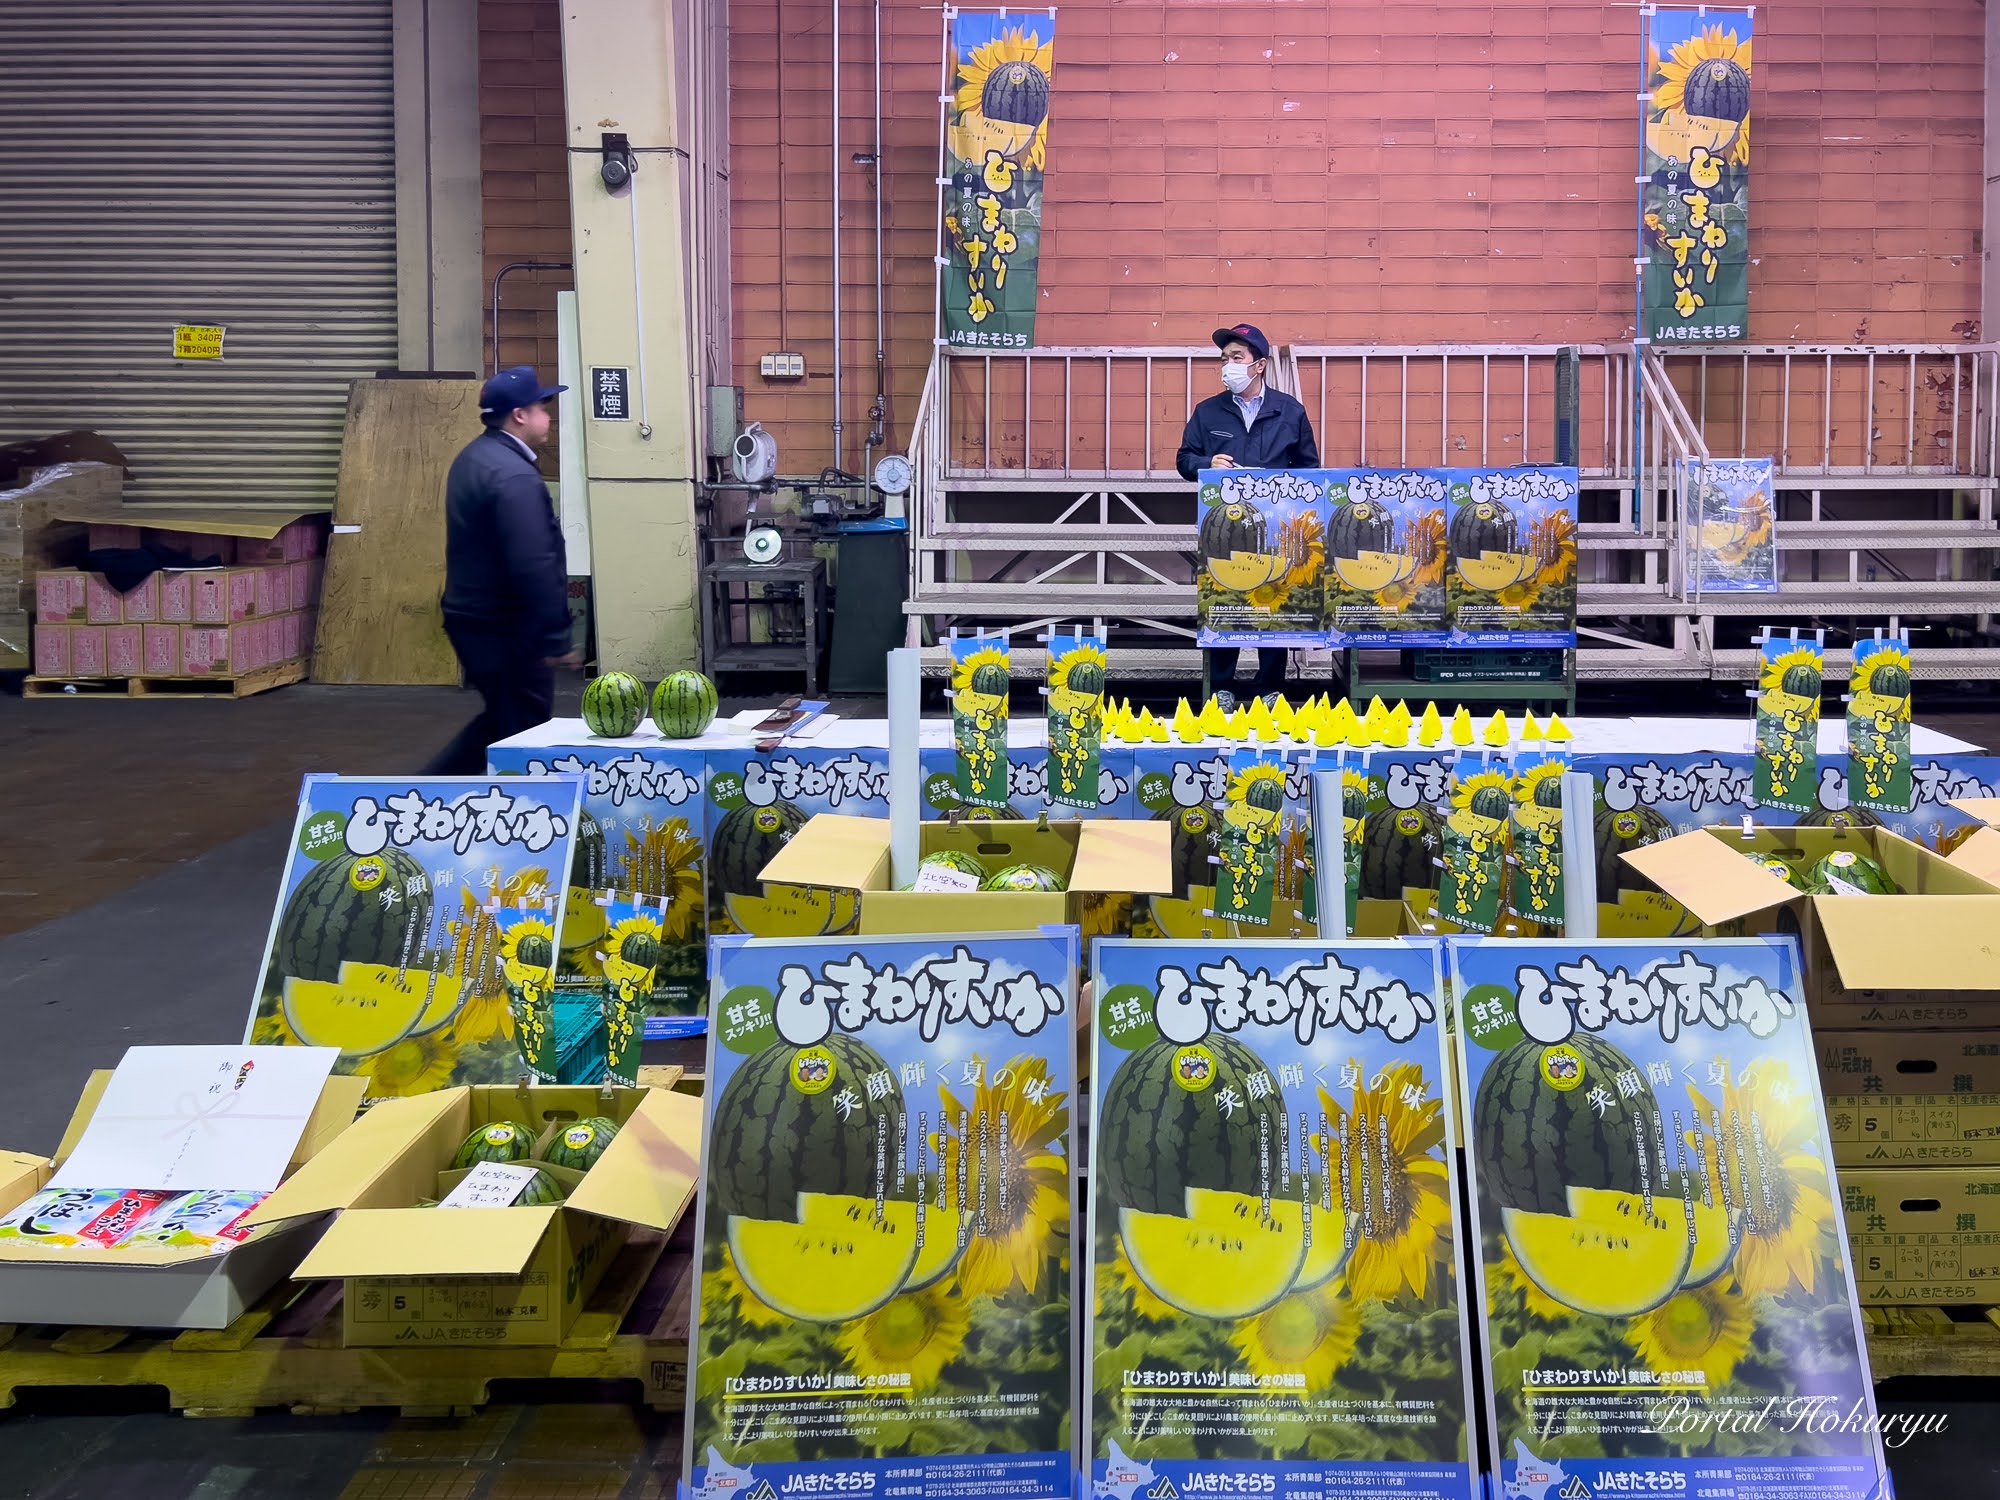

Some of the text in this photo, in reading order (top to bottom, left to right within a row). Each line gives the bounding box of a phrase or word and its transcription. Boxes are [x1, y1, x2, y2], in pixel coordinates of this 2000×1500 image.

[1666, 155, 1677, 231] あの夏の味。
[977, 149, 1019, 290] ひまわり
[1682, 146, 1728, 285] ひまわり
[962, 234, 995, 324] すいか
[1665, 230, 1704, 319] すいか
[198, 334, 221, 342] 340円
[949, 330, 1027, 348] JAきたそらち
[1655, 324, 1741, 340] JAきたそらち
[600, 370, 622, 416] 禁煙
[1220, 471, 1323, 504] ひまわりすいか
[1347, 471, 1446, 503] ひまわりすいか
[1469, 470, 1575, 504] ひまわりすいか
[1228, 634, 1259, 642] JAきたそらち
[1354, 634, 1386, 642] JAきたそらち
[1477, 634, 1509, 642] JAきたそらち
[972, 708, 999, 779] ひまわり
[1066, 707, 1090, 779] ひまわり
[1779, 709, 1804, 782] ひまわり
[1869, 709, 1896, 783] ひまわり
[965, 750, 987, 796] すいか
[1057, 749, 1077, 795] すいか
[1768, 751, 1790, 798] すいか
[1860, 751, 1886, 799] すいか
[715, 779, 736, 792] 甘さ
[930, 779, 950, 793] 甘さ
[1143, 780, 1163, 793] 甘さ
[965, 795, 1007, 810] JAきたそらち
[1054, 794, 1097, 810] JAきたそらち
[1760, 798, 1811, 813] JAきたそらち
[1856, 799, 1909, 814] JAきたそらち
[307, 819, 337, 838] 甘さ
[343, 785, 569, 856] ひまわりすいか
[304, 830, 343, 851] スッキリ!!
[1241, 822, 1265, 895] ひまわり
[1466, 830, 1489, 903] ひまわり
[1533, 822, 1558, 896] ひまわり
[1230, 862, 1250, 912] すいか
[1454, 870, 1474, 915] すいか
[1526, 863, 1550, 912] すいか
[1221, 911, 1269, 926] JAきたそらち
[1444, 913, 1493, 934] JAきたそらち
[1522, 912, 1564, 926] JAきたそら
[777, 945, 1065, 1049] ひまわりすいか
[1153, 952, 1436, 1045] ひまわりすいか
[1515, 950, 1796, 1046] ひまわりすいか
[521, 980, 546, 1052] ひまわり
[726, 999, 761, 1026] 甘さ
[1108, 997, 1141, 1020] 甘さ
[1471, 999, 1504, 1021] 甘さ
[1888, 1008, 1968, 1020] JAきたそらち
[724, 1011, 773, 1042] スッキリ!!
[1108, 1010, 1153, 1037] スッキリ!!
[1472, 1012, 1516, 1038] スッキリ!!
[518, 1020, 539, 1065] すいか
[1842, 1057, 1872, 1073] 元気村
[833, 1058, 1055, 1122] 笑顔輝く夏の味。
[1214, 1063, 1434, 1121] 笑顔輝く夏の味。
[1864, 1074, 1973, 1092] 共 撰
[1834, 1113, 1853, 1132] 秀
[1865, 1118, 1878, 1131] 5
[1893, 1146, 1973, 1159] JAきたそらち
[1845, 1195, 1876, 1212] 元気村
[1867, 1213, 1976, 1232] 共 撰
[1869, 1257, 1881, 1271] 5
[394, 1296, 406, 1309] 5
[1896, 1286, 1976, 1299] JAきたそらち
[423, 1327, 507, 1340] JAきたそらち
[725, 1372, 911, 1394] 「ひまわりすいか」美味しさの秘密
[1123, 1370, 1306, 1388] 「ひまわりすいか」美味しさの秘密
[1522, 1368, 1707, 1386] 「ひまわりすいか」美味しさの秘密
[781, 1471, 876, 1493] JAきたそらち
[1181, 1472, 1276, 1492] JAきたそらち
[1593, 1471, 1686, 1490] JAきたそらち
